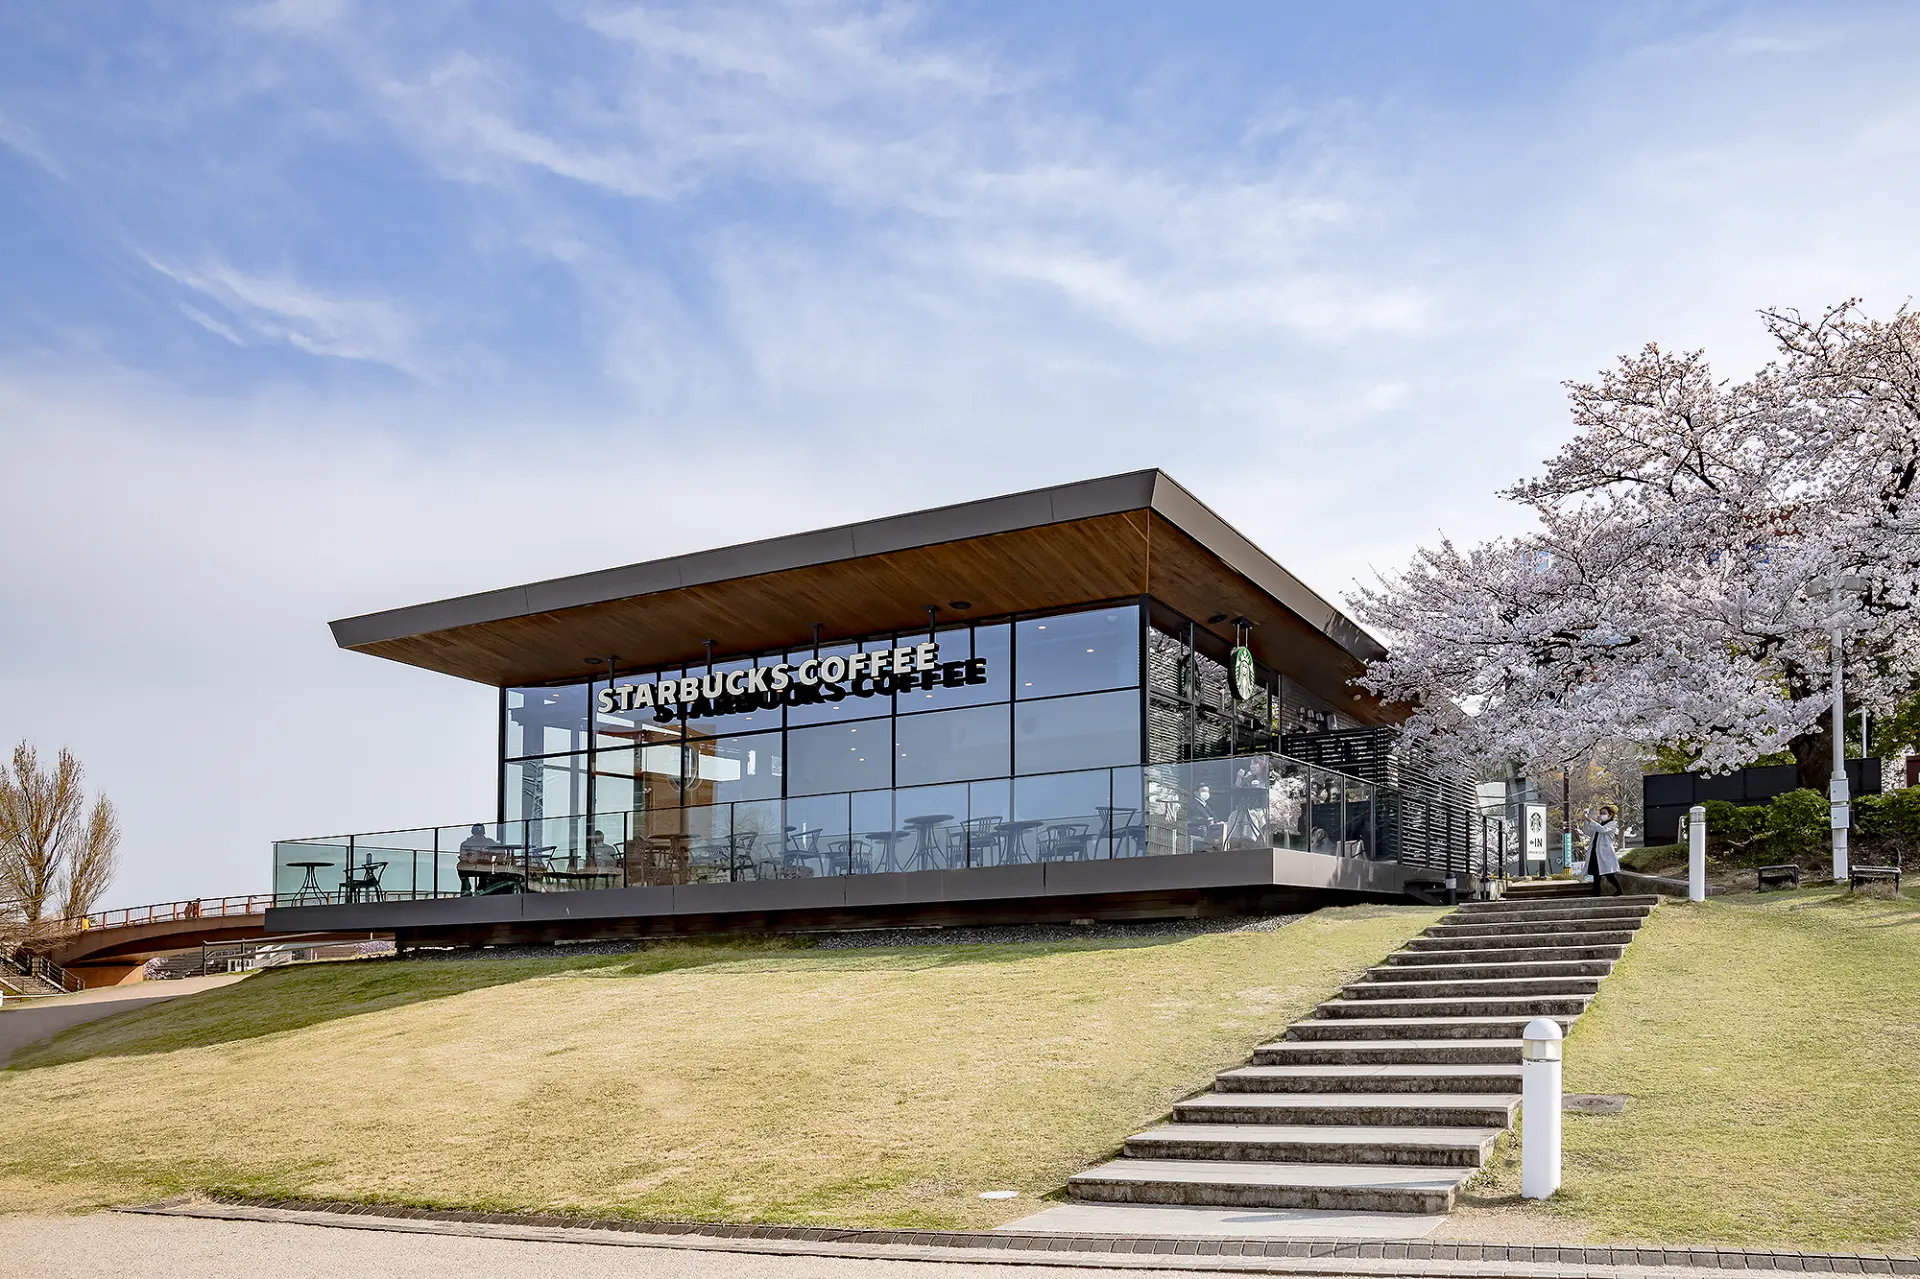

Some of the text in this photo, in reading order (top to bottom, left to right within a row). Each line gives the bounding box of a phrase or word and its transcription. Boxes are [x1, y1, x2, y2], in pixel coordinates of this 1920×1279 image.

[597, 663, 789, 714] STARBUCKS
[798, 643, 936, 686] COFFEE
[1534, 837, 1543, 848] IN
